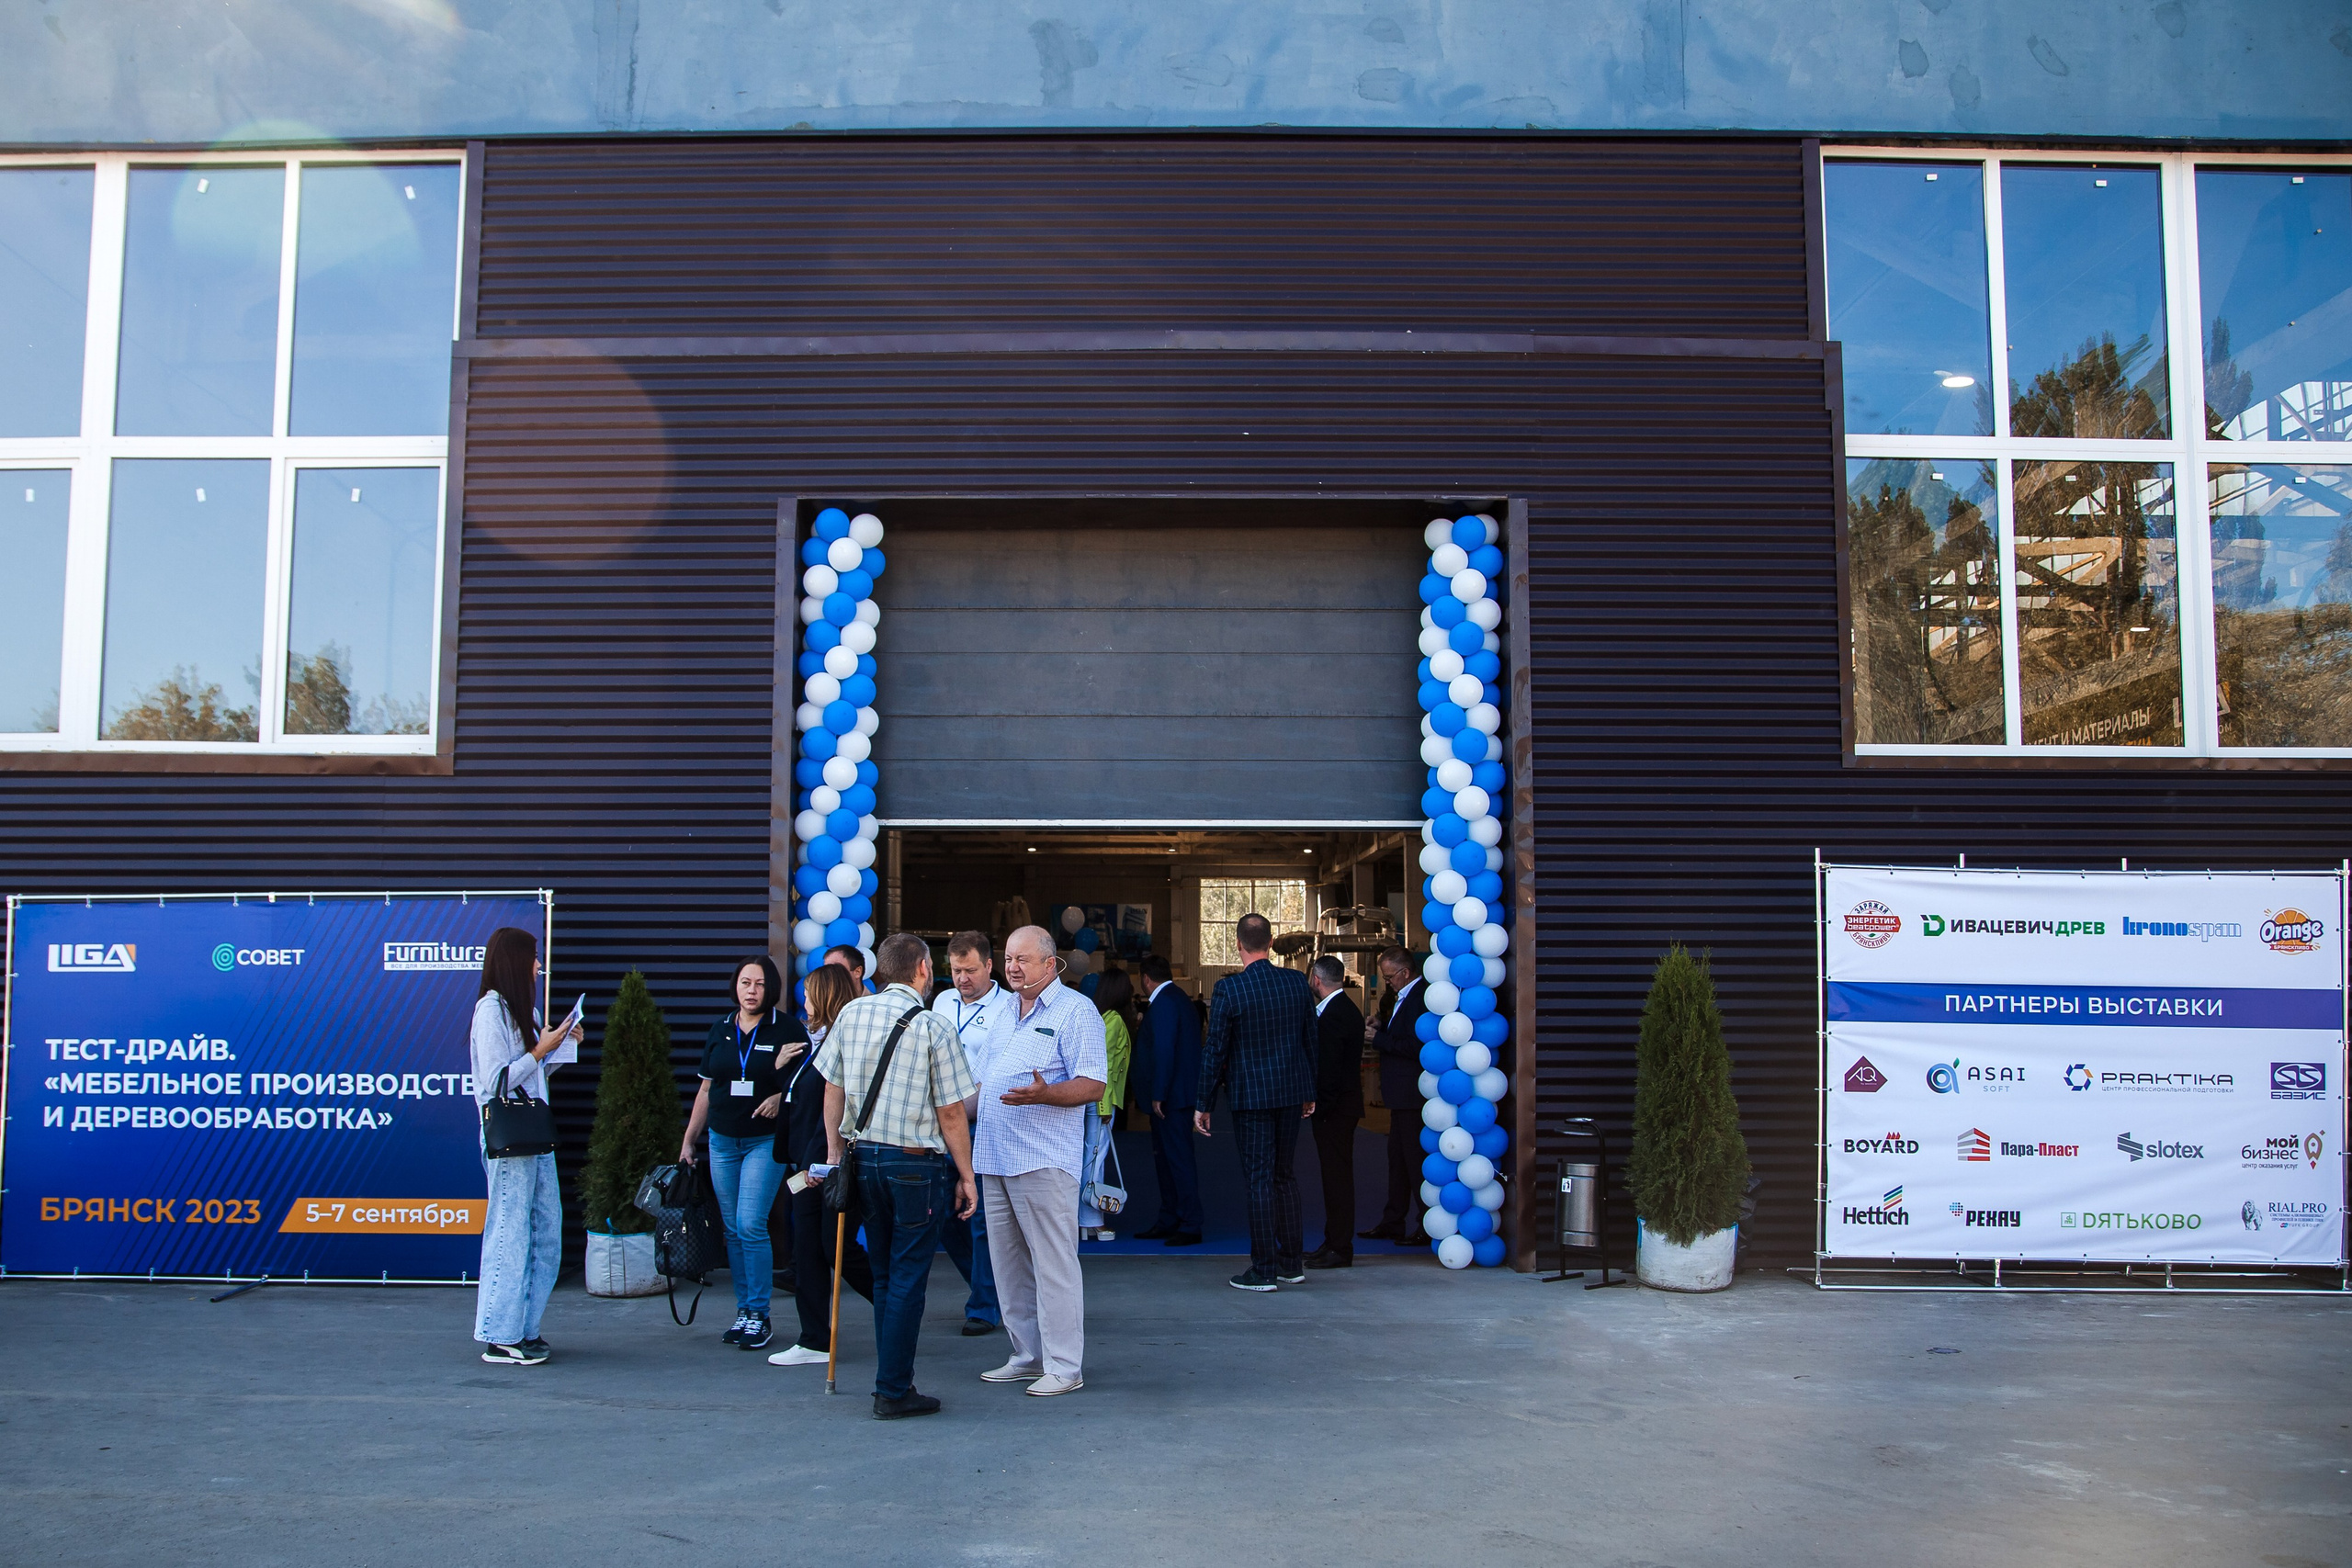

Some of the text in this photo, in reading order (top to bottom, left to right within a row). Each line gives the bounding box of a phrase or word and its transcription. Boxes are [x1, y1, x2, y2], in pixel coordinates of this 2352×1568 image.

[2072, 706, 2151, 745] МАТЕРИАЛЫ
[1854, 902, 1889, 915] ЗАРЯЖАЙ
[1951, 919, 2105, 937] ИВАЦЕВИЧДРЕВ
[2122, 916, 2242, 942] kronospan
[2261, 919, 2324, 942] Orange
[1852, 931, 1891, 947] БРЯНСКПИВО
[48, 943, 136, 972] LIGA
[237, 949, 305, 965] СОВЕТ
[1945, 994, 2222, 1016] ПАРТНЕРЫ ВЫСТАВКИ
[45, 1033, 236, 1065] ТЕСТ-ДРАЙВ.
[1848, 1066, 1877, 1082] AQ
[1967, 1066, 2026, 1081] ASAI
[2101, 1072, 2233, 1086] PRAKTIKA
[44, 1072, 475, 1100] «МЕБЕЛЬНОЕ ПРОИЗВОДСТВ
[43, 1106, 393, 1132] И ДЕРЕВООБРАБОТКА»
[1844, 1138, 1919, 1154] BOYARD
[2000, 1142, 2079, 1157] Пара-Пласт
[2146, 1140, 2204, 1159] slotex
[2266, 1134, 2299, 1148] мой
[2241, 1145, 2299, 1159] бизнес
[40, 1197, 262, 1224] БРЯНСК 2023
[352, 1202, 469, 1228] сентября
[1843, 1206, 1909, 1225] Hettich
[2268, 1202, 2327, 1213] RIAL.PRO
[1966, 1210, 2021, 1227] РЕХАУ
